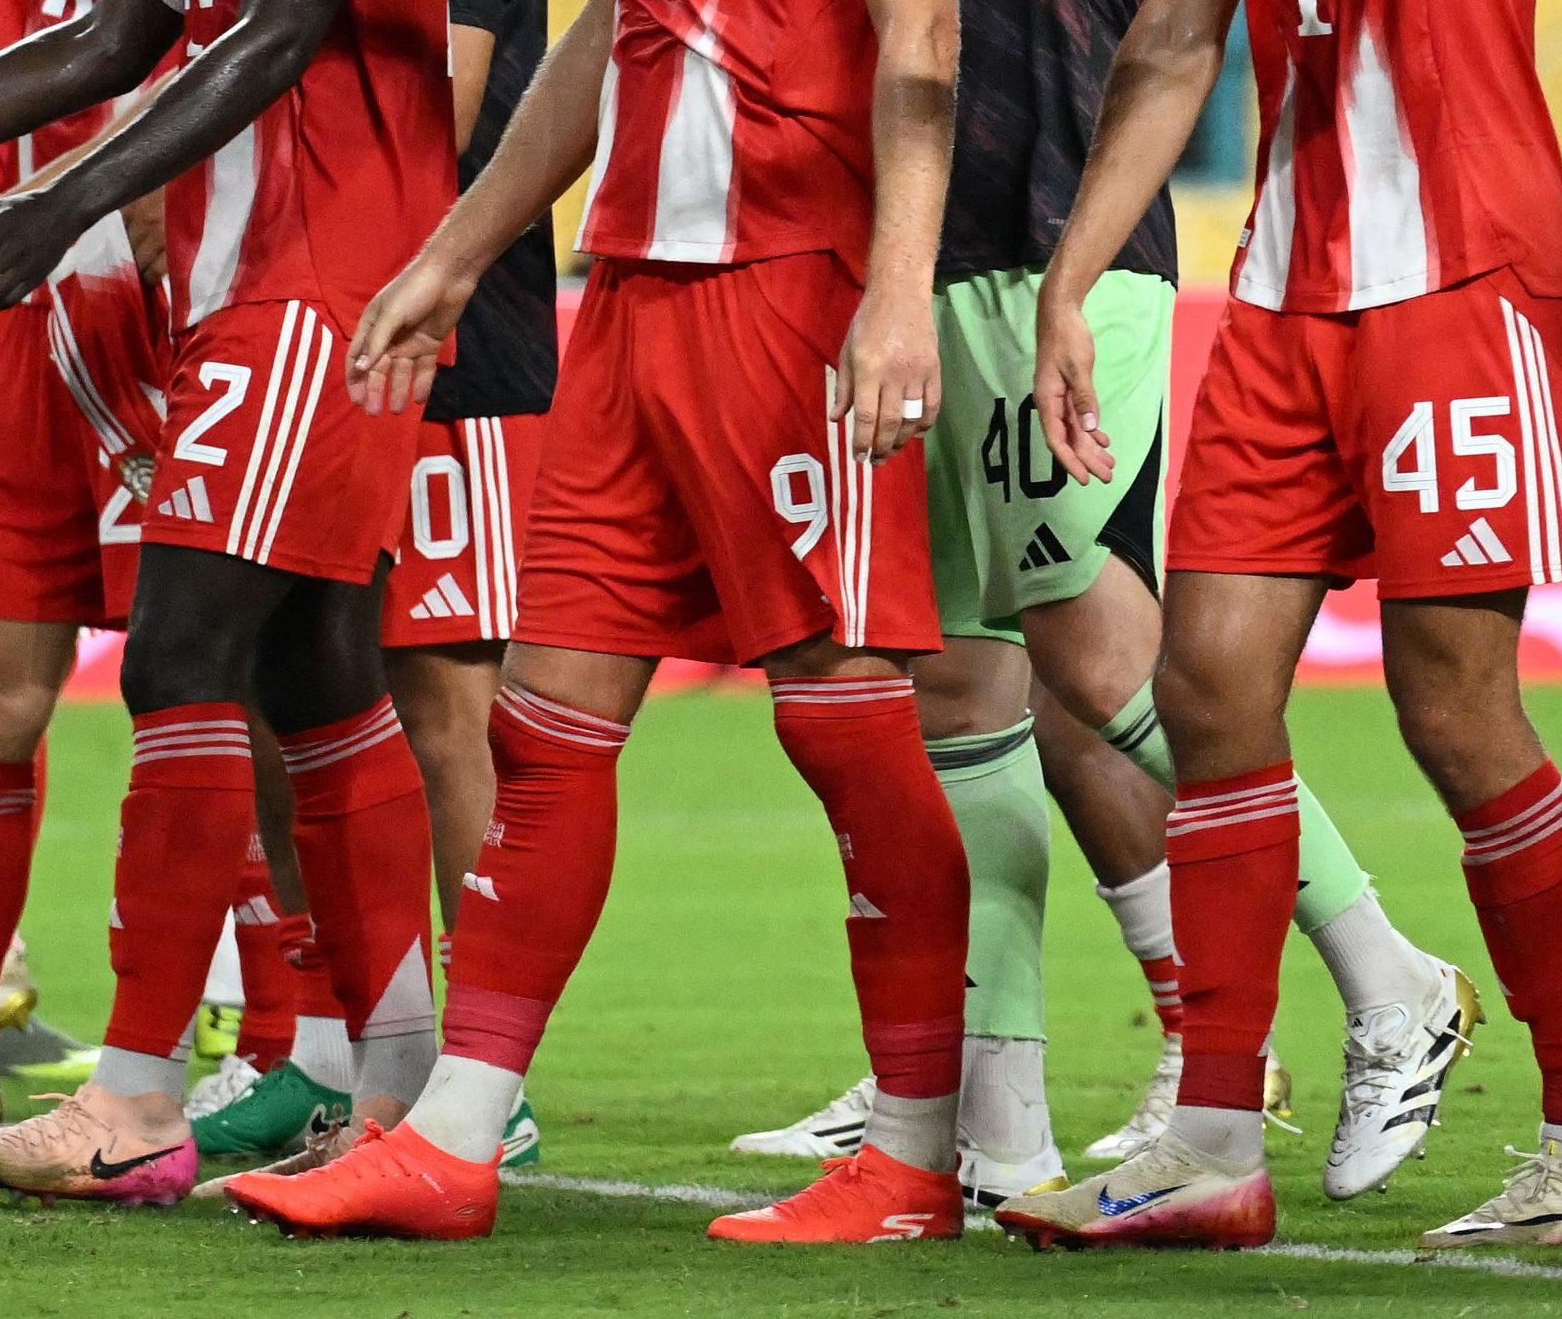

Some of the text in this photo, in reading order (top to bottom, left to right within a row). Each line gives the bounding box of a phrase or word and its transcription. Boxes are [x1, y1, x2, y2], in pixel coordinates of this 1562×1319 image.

[173, 362, 251, 467] 2
[981, 393, 1070, 504] 40
[1382, 396, 1518, 514] 45
[769, 453, 829, 563] 9
